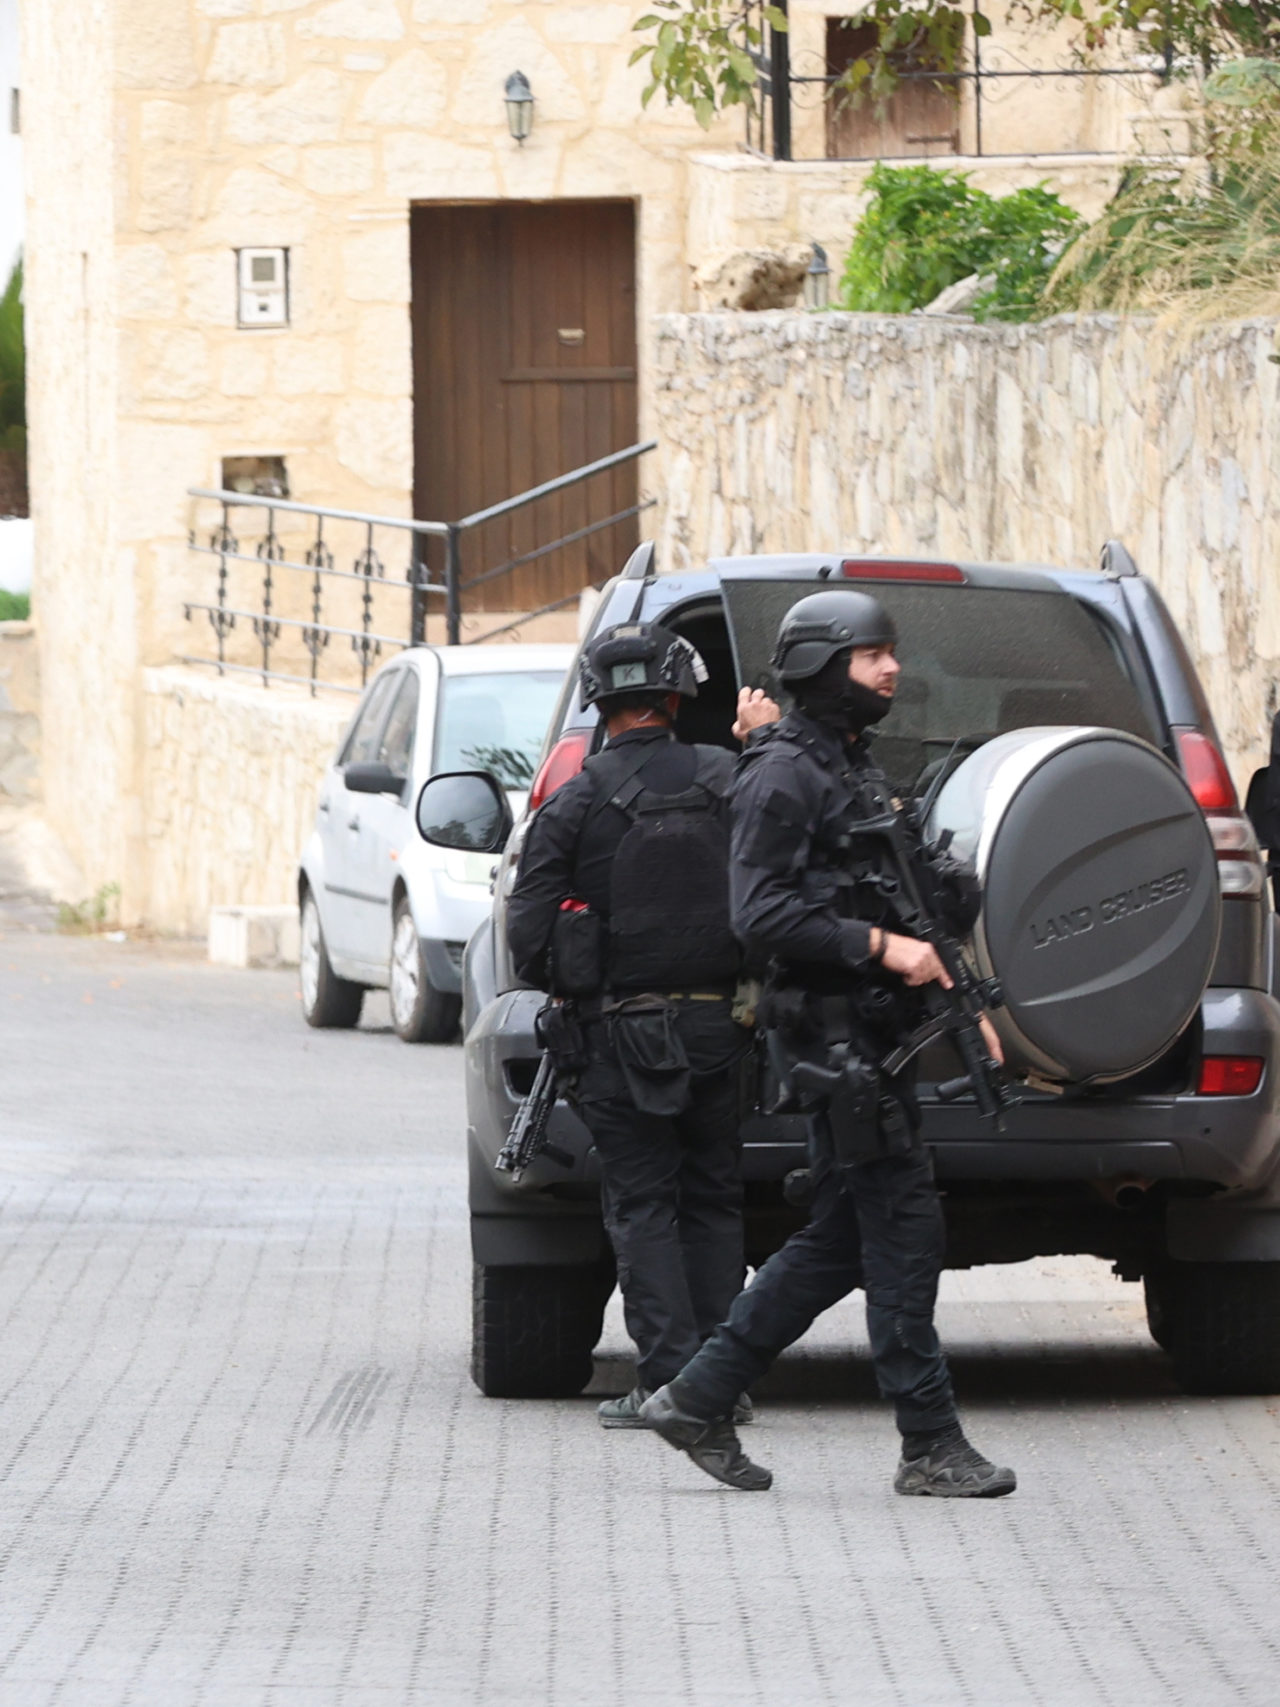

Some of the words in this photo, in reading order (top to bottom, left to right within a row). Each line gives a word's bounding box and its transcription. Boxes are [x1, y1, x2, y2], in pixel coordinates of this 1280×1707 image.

[623, 666, 636, 681] K
[1030, 905, 1094, 950] LAND
[1099, 867, 1191, 924] CRUISER
